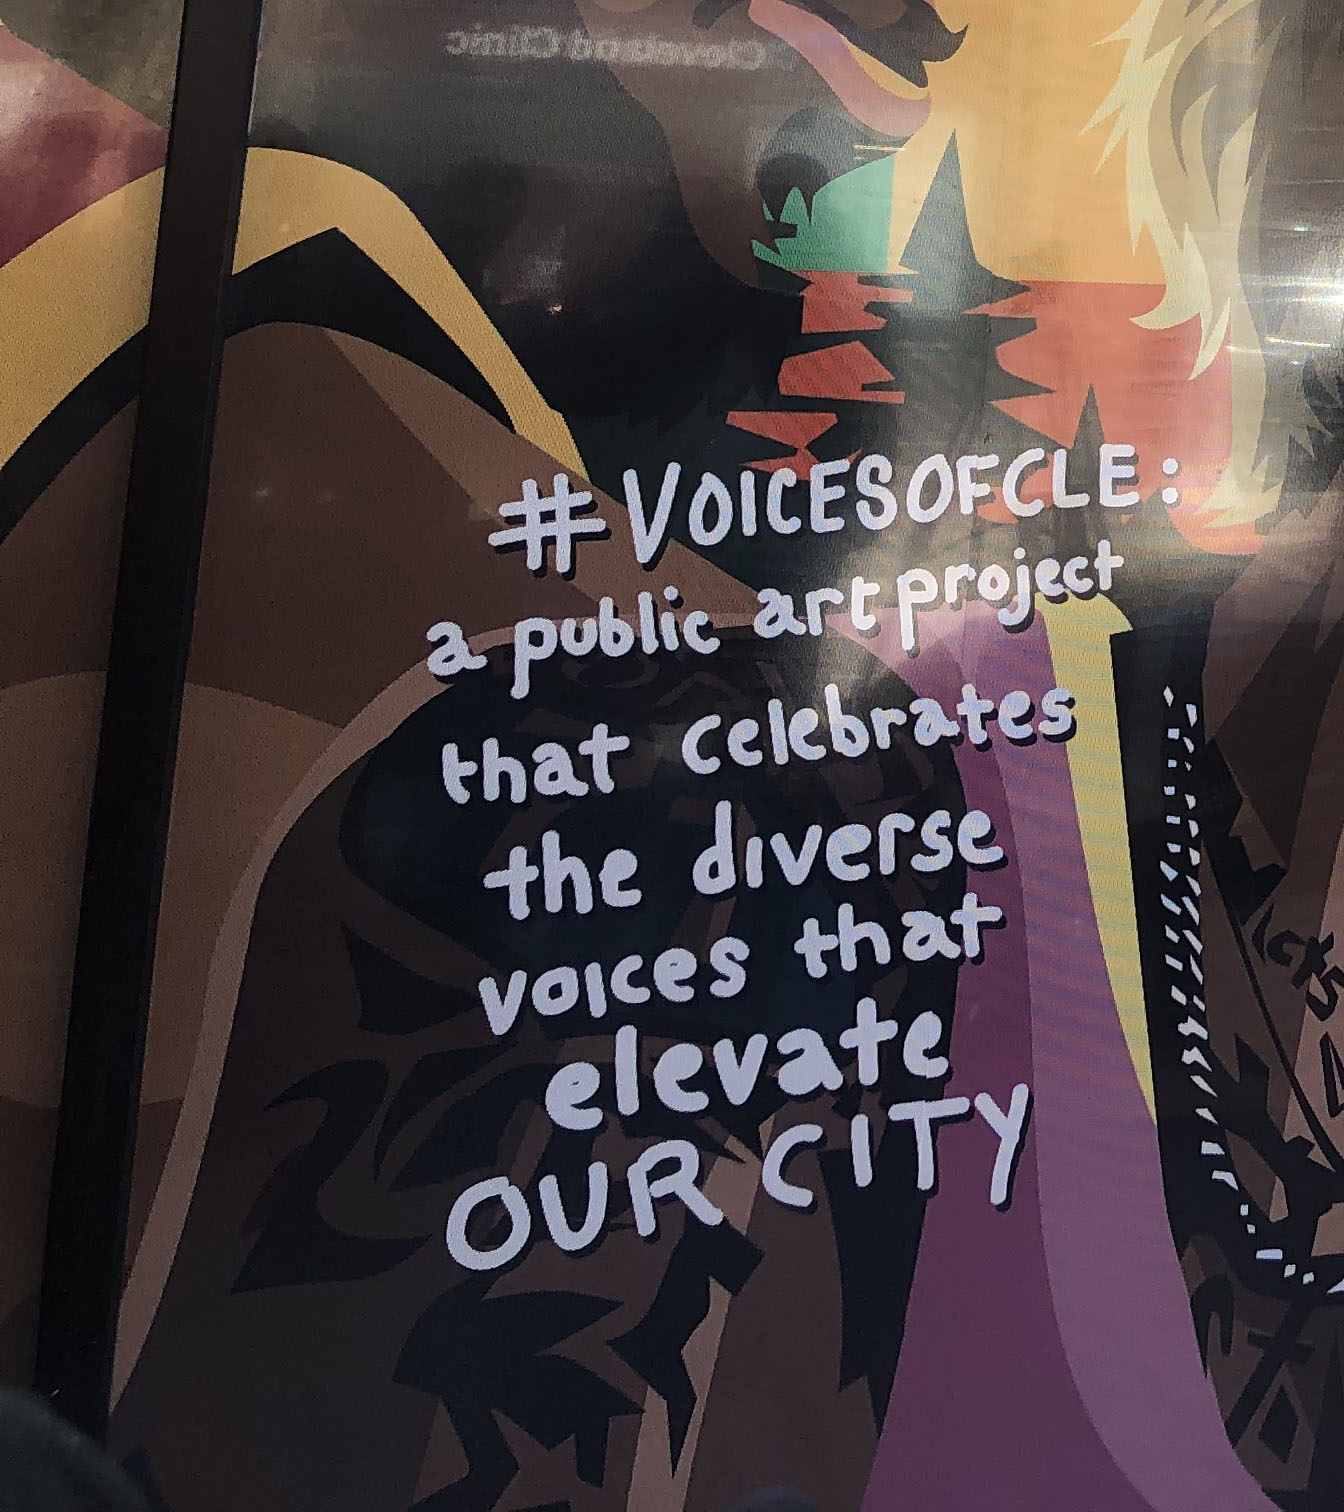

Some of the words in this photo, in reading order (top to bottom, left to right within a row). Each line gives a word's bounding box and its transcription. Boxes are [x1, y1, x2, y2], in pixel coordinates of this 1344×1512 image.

[488, 444, 1180, 573] #VOICESOFCLE:
[427, 620, 486, 678] a
[511, 589, 721, 699] public
[754, 573, 880, 638] art
[898, 539, 1124, 650] project
[442, 722, 629, 805] that
[682, 683, 1076, 775] celebrates
[484, 830, 642, 921] the
[693, 800, 1004, 896] diverse
[478, 936, 750, 1035] voices
[795, 893, 1003, 979] that
[545, 997, 949, 1133] elevate
[445, 1141, 722, 1272] OUR
[761, 1082, 1029, 1209] CITY
